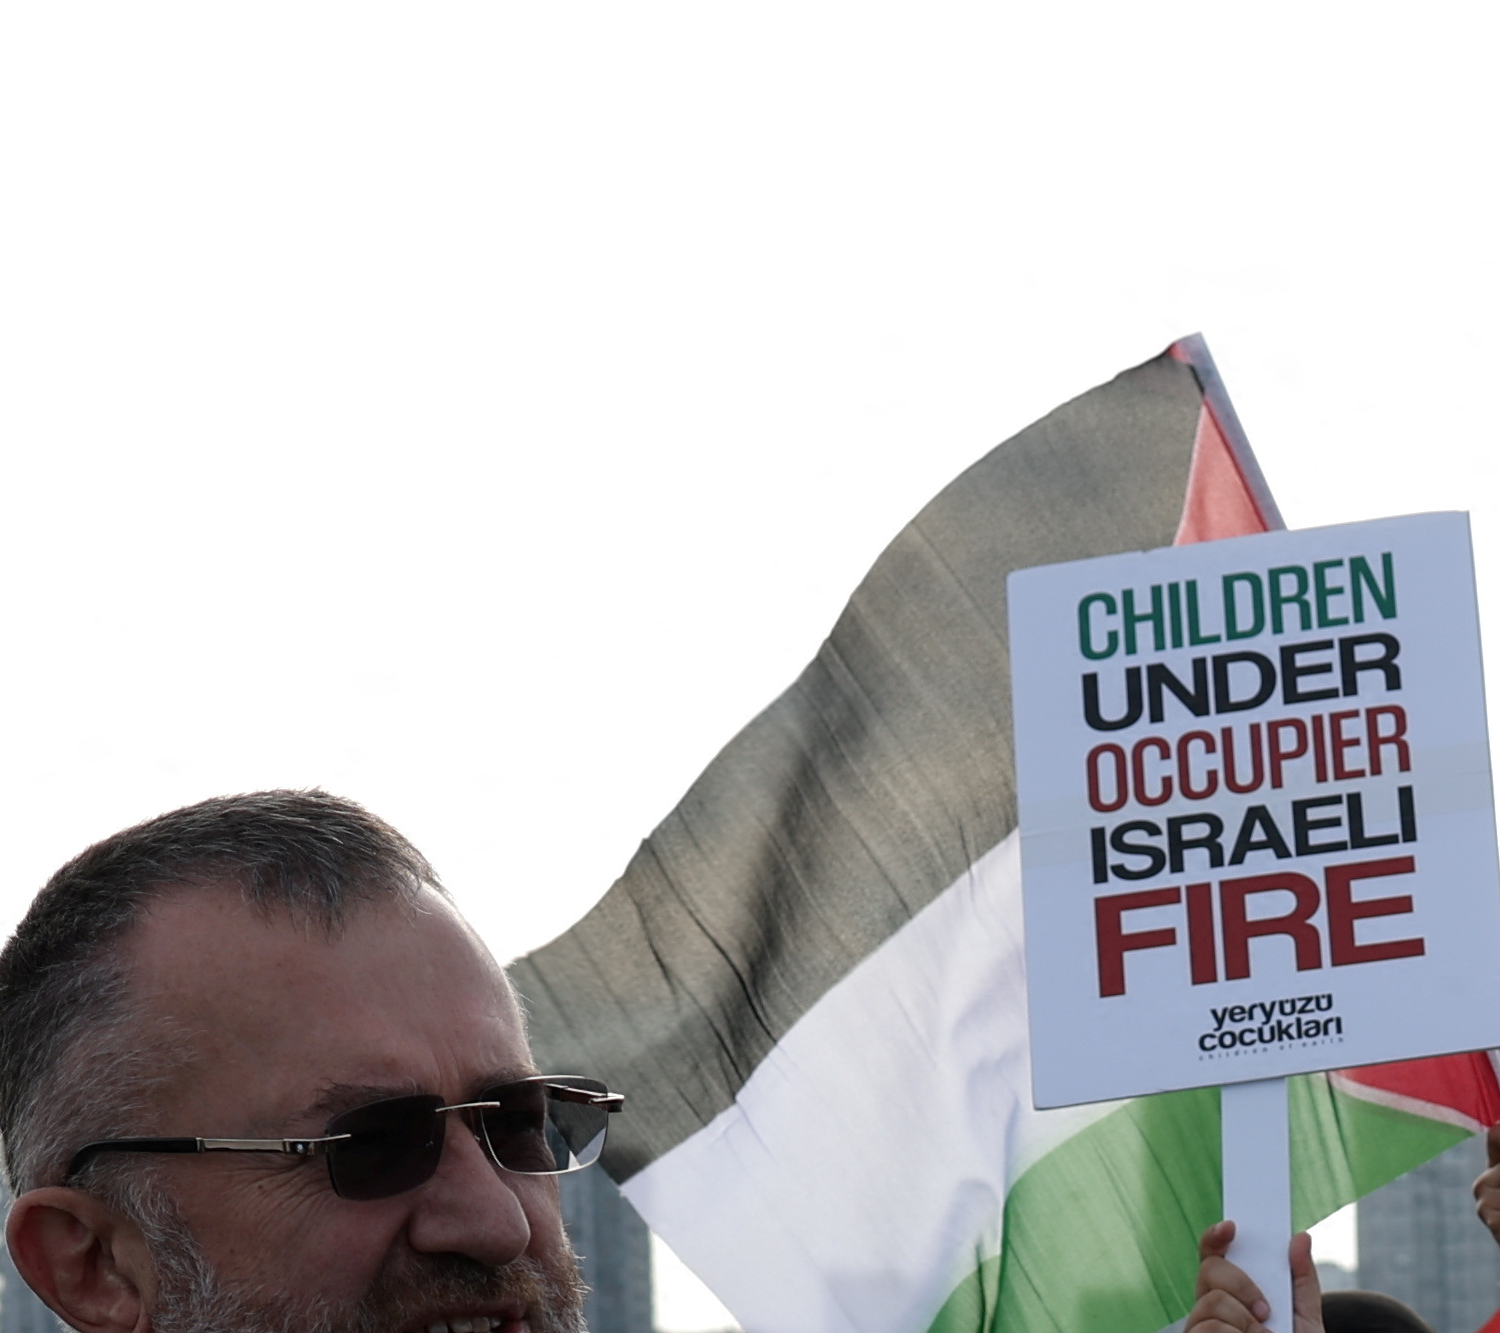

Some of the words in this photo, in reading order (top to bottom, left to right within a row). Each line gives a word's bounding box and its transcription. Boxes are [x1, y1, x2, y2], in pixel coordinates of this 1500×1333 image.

[1077, 551, 1399, 662] CHILDREN
[1081, 632, 1402, 732] UNDER
[1086, 704, 1412, 814] OCCUPIER
[1090, 785, 1418, 885] ISRAELI
[1094, 855, 1426, 999] FIRE
[1210, 993, 1333, 1031] yeryüzü
